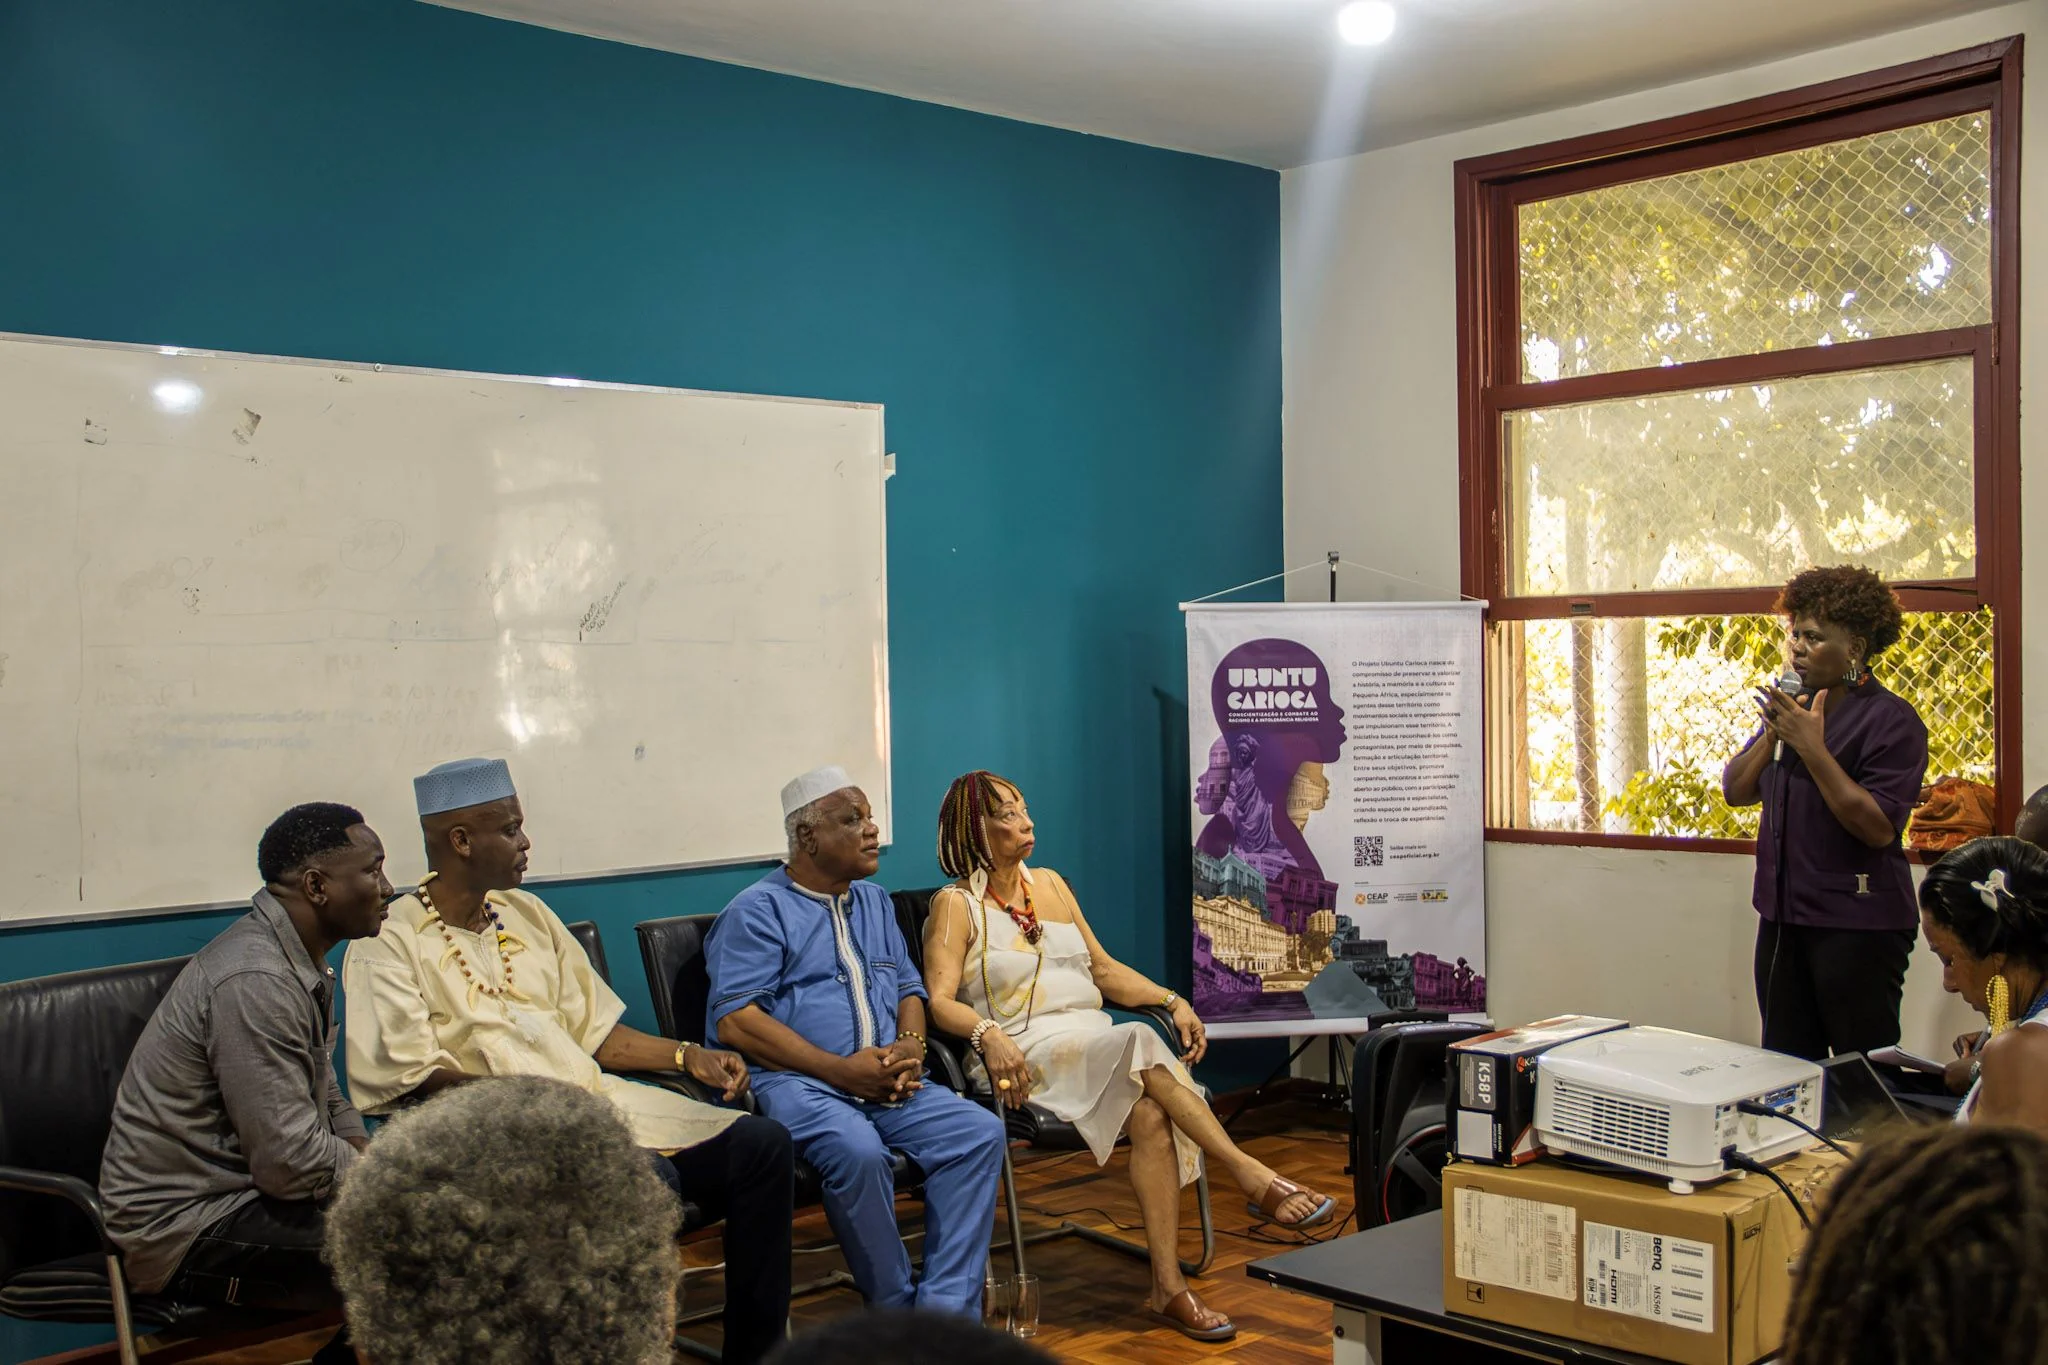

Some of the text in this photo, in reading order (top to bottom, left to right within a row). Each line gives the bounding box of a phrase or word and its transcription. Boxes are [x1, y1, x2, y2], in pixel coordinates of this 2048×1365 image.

[1228, 668, 1316, 688] UBUNTU
[1227, 691, 1318, 710] CARIOCA
[1478, 1062, 1491, 1104] K58P
[1623, 1232, 1631, 1253] SVGA
[1651, 1237, 1662, 1271] BenQ
[1653, 1284, 1661, 1315] MS560
